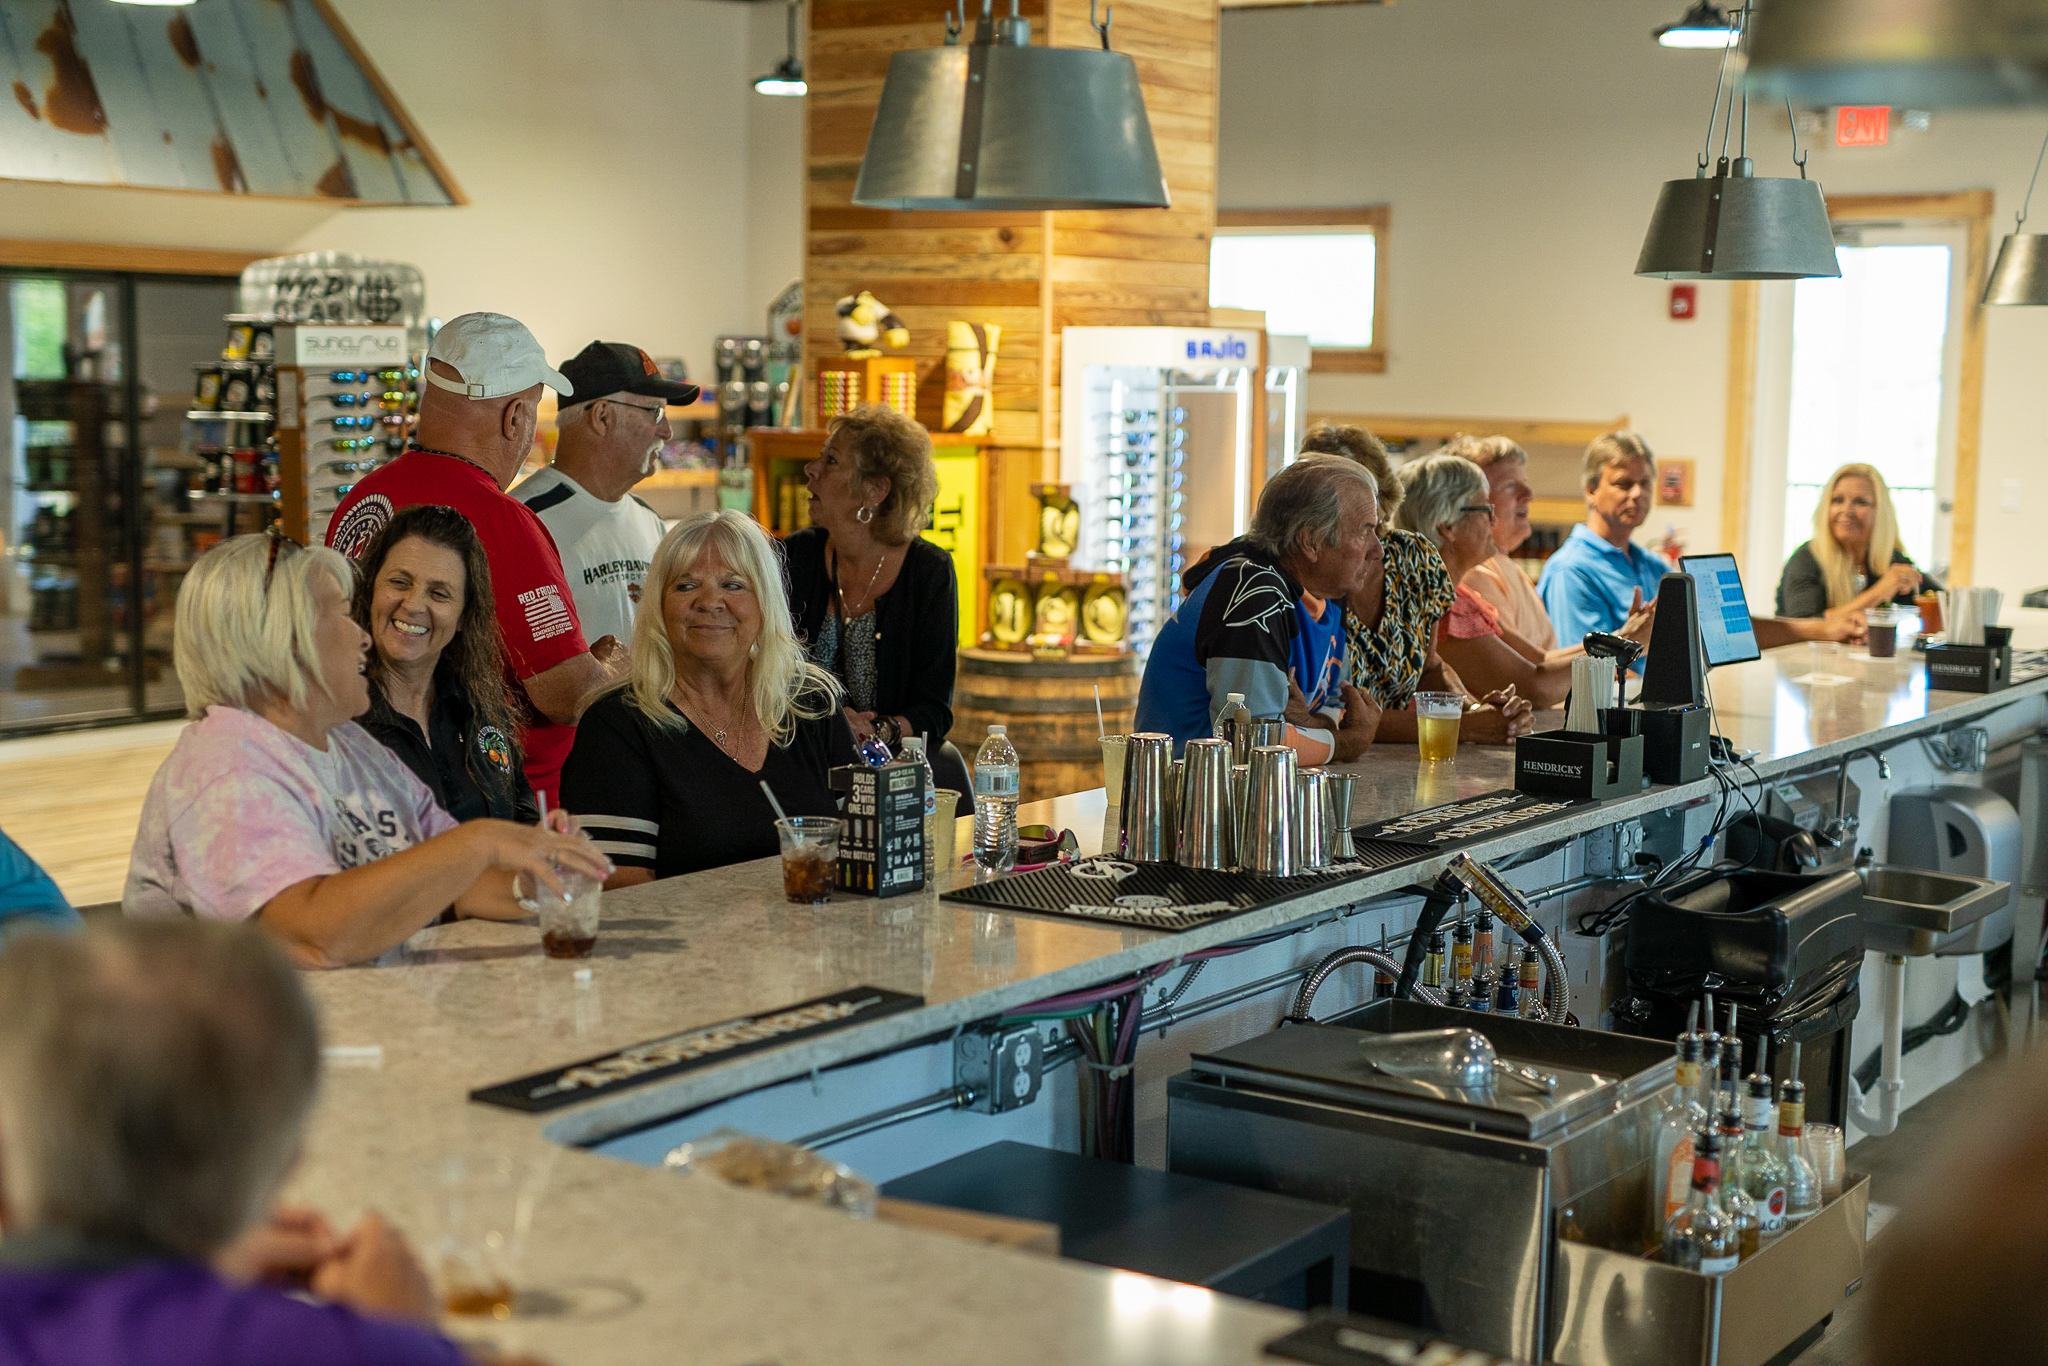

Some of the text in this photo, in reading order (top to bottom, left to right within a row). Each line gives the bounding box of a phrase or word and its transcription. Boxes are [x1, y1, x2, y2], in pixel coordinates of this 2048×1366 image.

[355, 506, 377, 519] STATES
[517, 584, 560, 605] RED FRIDAY
[1523, 760, 1582, 775] HENDRICK'S
[853, 772, 875, 785] HOLDS
[852, 784, 860, 803] 3
[848, 802, 861, 815] ONE
[853, 850, 875, 862] BOTTLES
